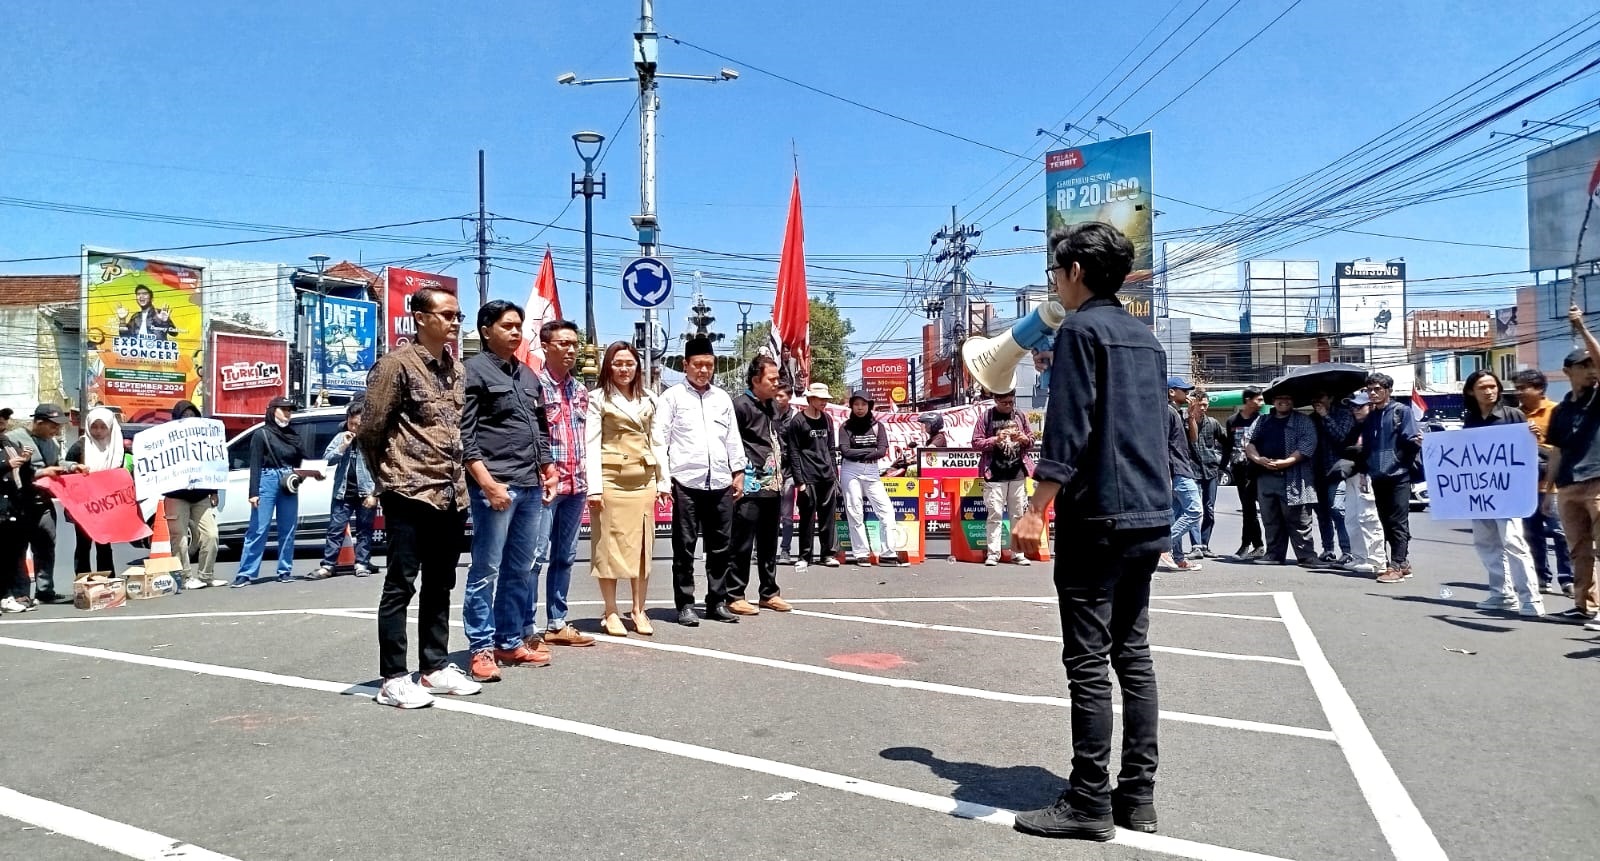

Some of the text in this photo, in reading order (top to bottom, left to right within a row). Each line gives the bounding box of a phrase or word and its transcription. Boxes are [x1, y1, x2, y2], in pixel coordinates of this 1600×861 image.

[1056, 187, 1076, 211] RP
[1079, 177, 1139, 208] 20.000
[1418, 320, 1489, 338] REDSHOP
[120, 347, 179, 361] CONCERT
[866, 364, 902, 373] erafone
[114, 382, 164, 390] SEPTEMBER
[1438, 443, 1525, 467] KAWAL
[1437, 472, 1510, 497] PUTUSAN
[1469, 494, 1496, 511] MK
